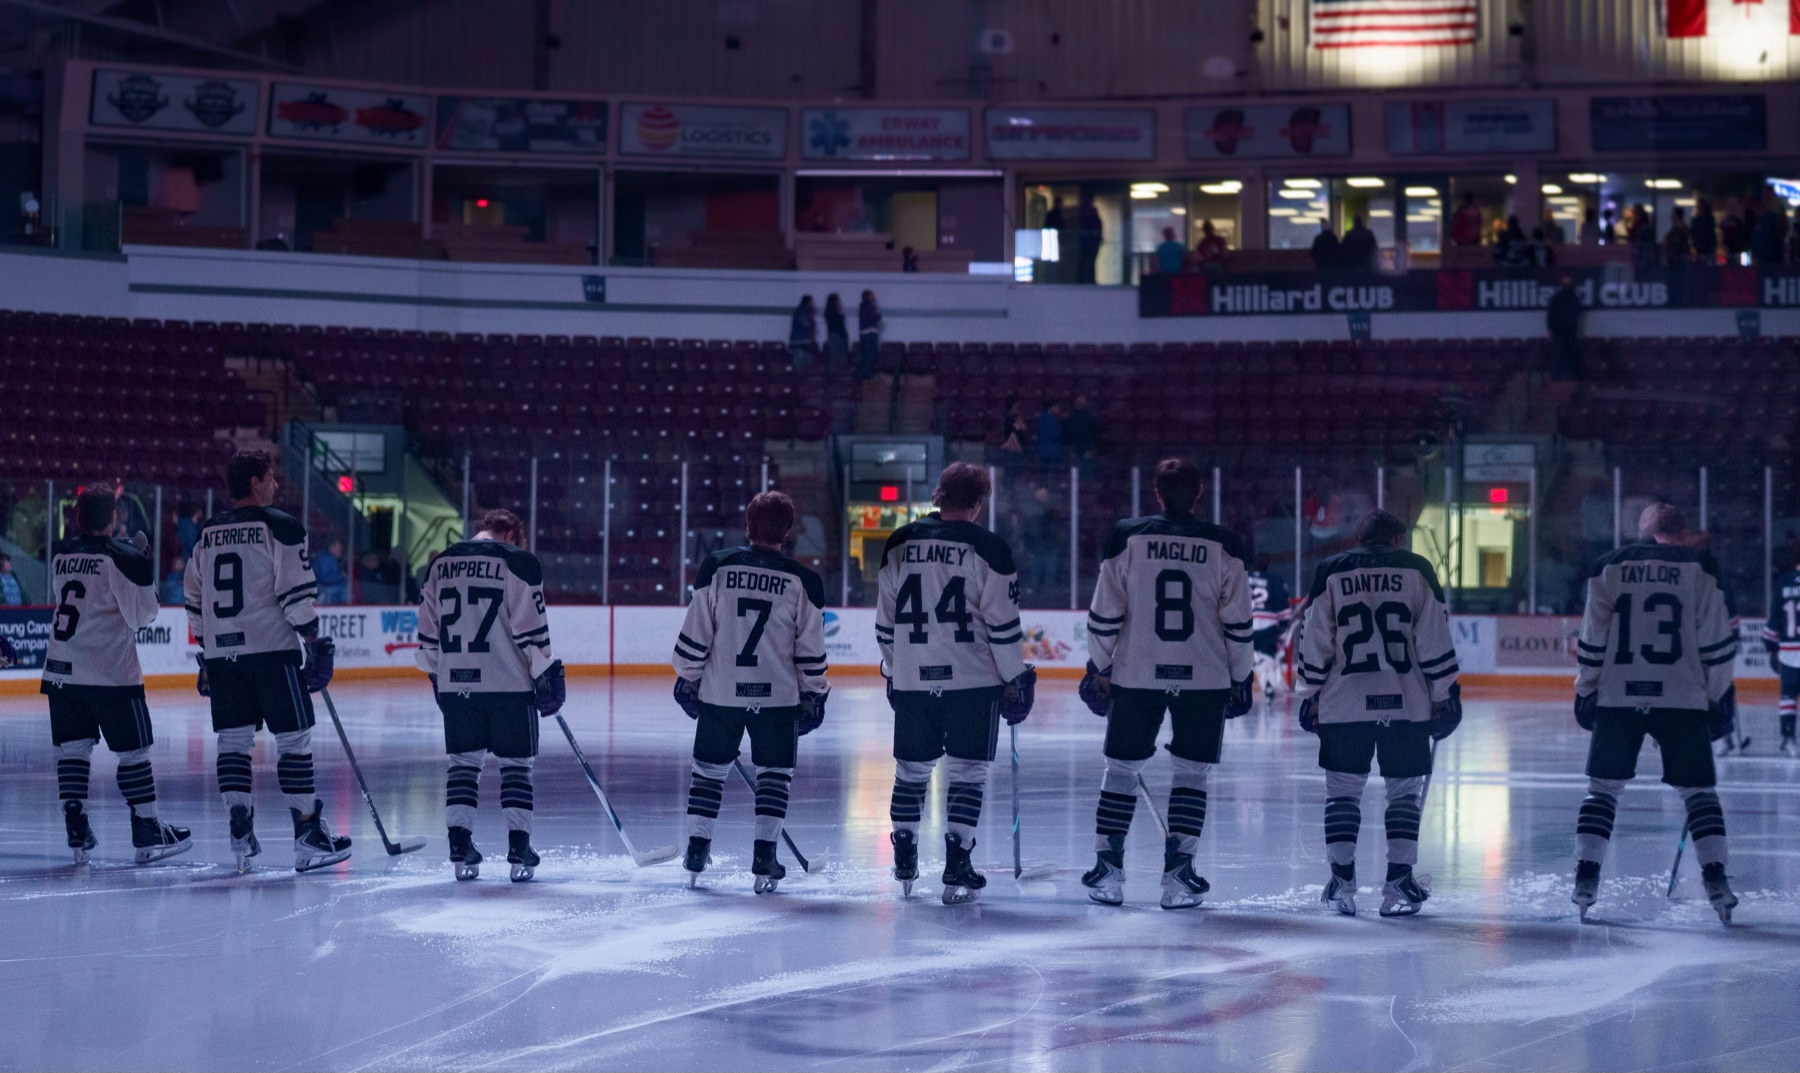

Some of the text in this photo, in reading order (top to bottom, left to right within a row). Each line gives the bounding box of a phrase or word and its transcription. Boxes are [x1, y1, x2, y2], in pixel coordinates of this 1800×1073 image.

[681, 128, 772, 145] LOGISTICS
[881, 116, 941, 131] ERWAY
[856, 135, 964, 150] AMBULANCE
[1212, 283, 1394, 313] Hilliard CLUB
[1478, 279, 1668, 308] Hilliad CLUB
[201, 527, 264, 549] AFERRIERE
[1147, 541, 1207, 564] MAGLIO
[213, 552, 244, 619] 9
[726, 571, 792, 596] BEDORF
[1340, 574, 1403, 597] DANTAS
[1621, 565, 1681, 586] TAYLOR
[53, 579, 87, 642] 6
[894, 573, 975, 644] 44
[1155, 568, 1195, 642] 8
[318, 615, 367, 638] TREET
[439, 586, 505, 654] 27
[735, 597, 773, 668] 7
[1612, 592, 1683, 665] 13
[1336, 601, 1413, 676] 26
